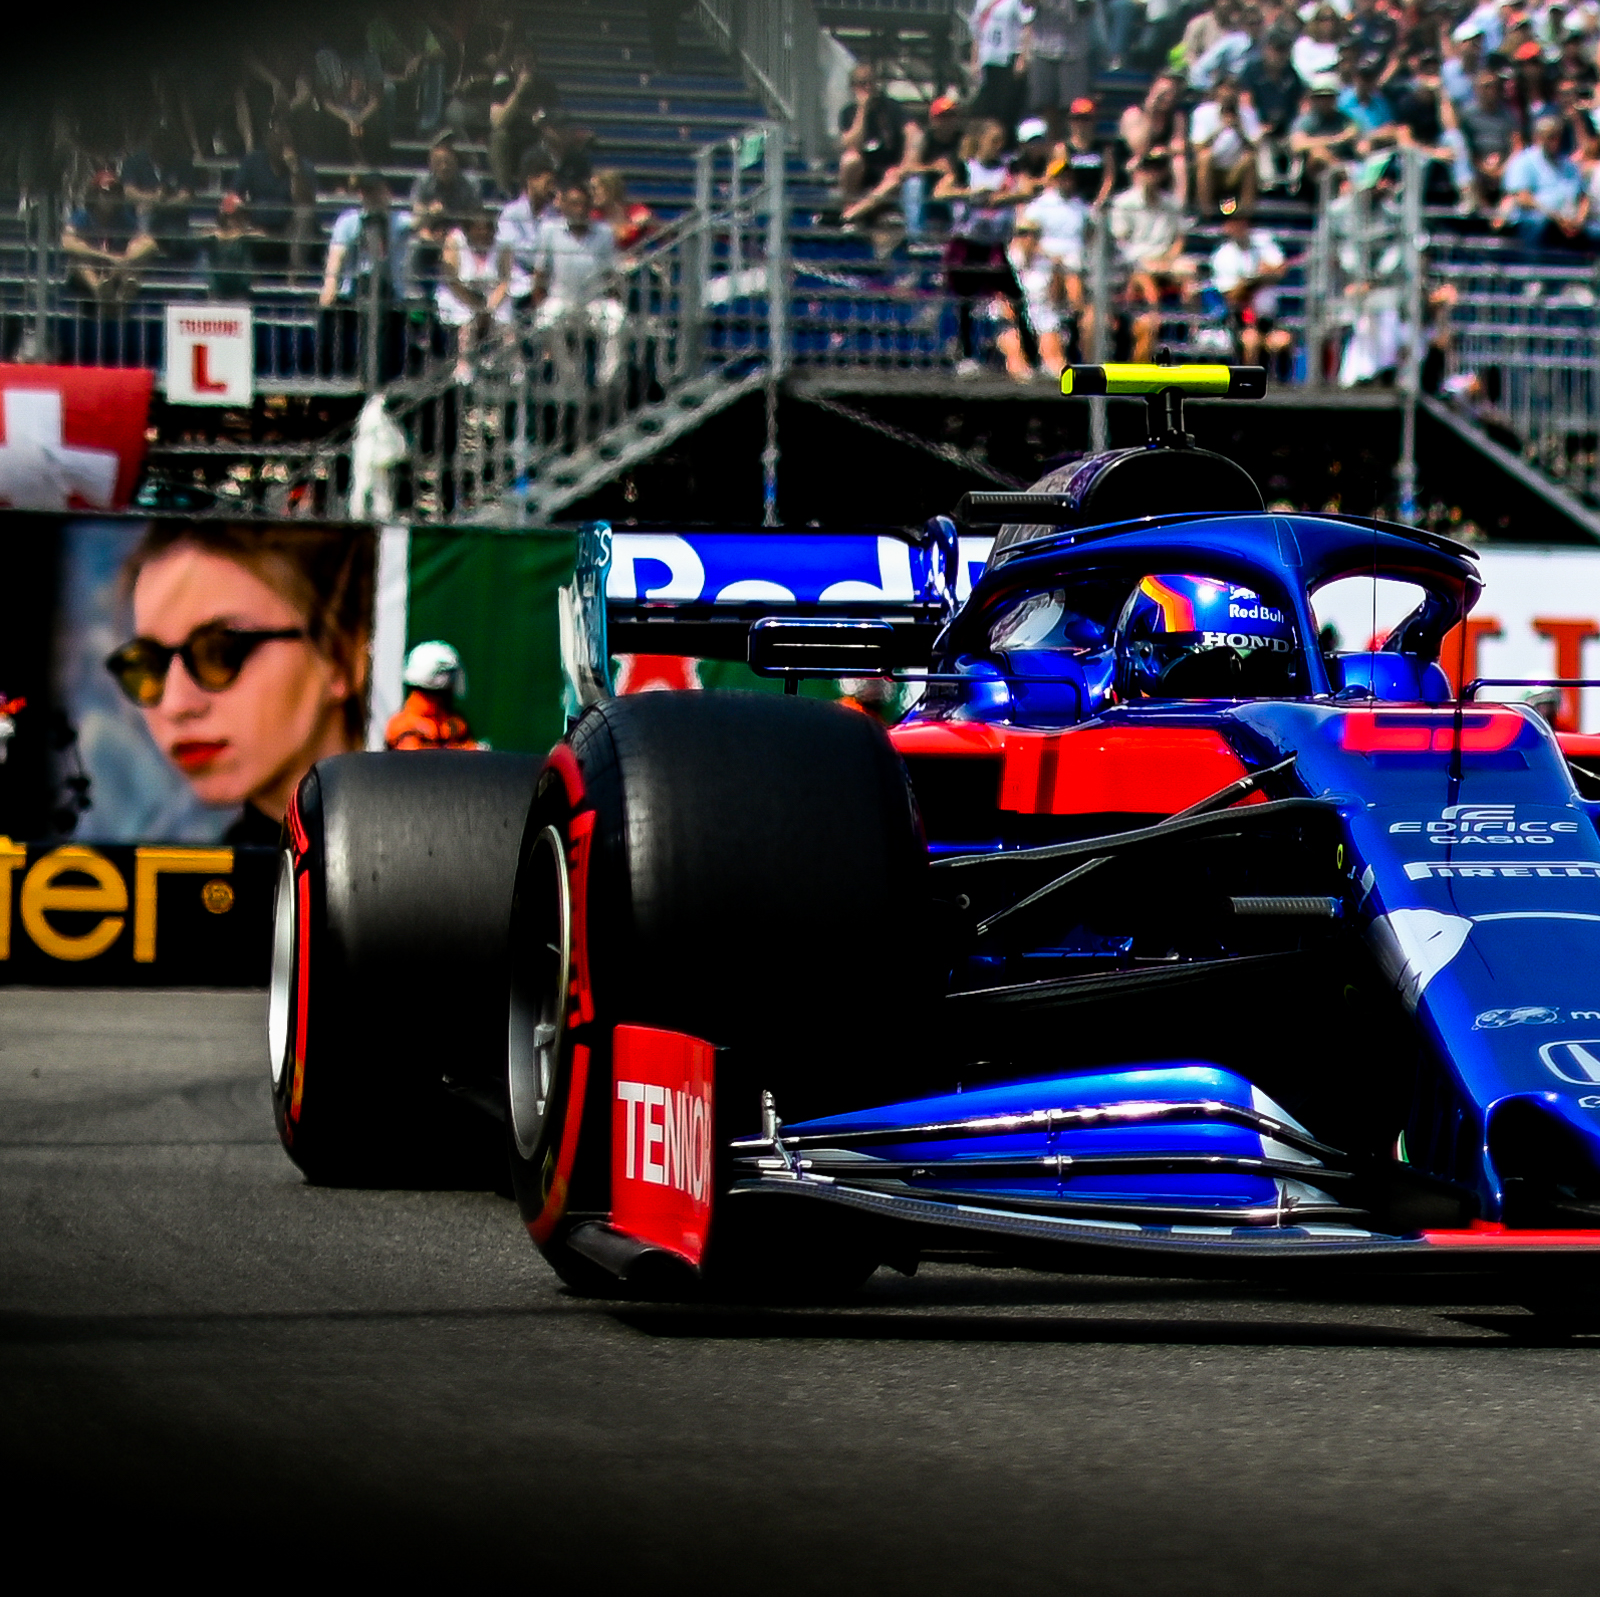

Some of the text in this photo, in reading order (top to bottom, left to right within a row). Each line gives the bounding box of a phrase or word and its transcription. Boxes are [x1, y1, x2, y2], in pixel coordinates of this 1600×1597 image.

[191, 343, 229, 394] L
[1229, 603, 1259, 619] Red
[1201, 631, 1291, 653] HOND
[1388, 821, 1578, 834] EDIFICE
[1428, 835, 1555, 844] CASIO
